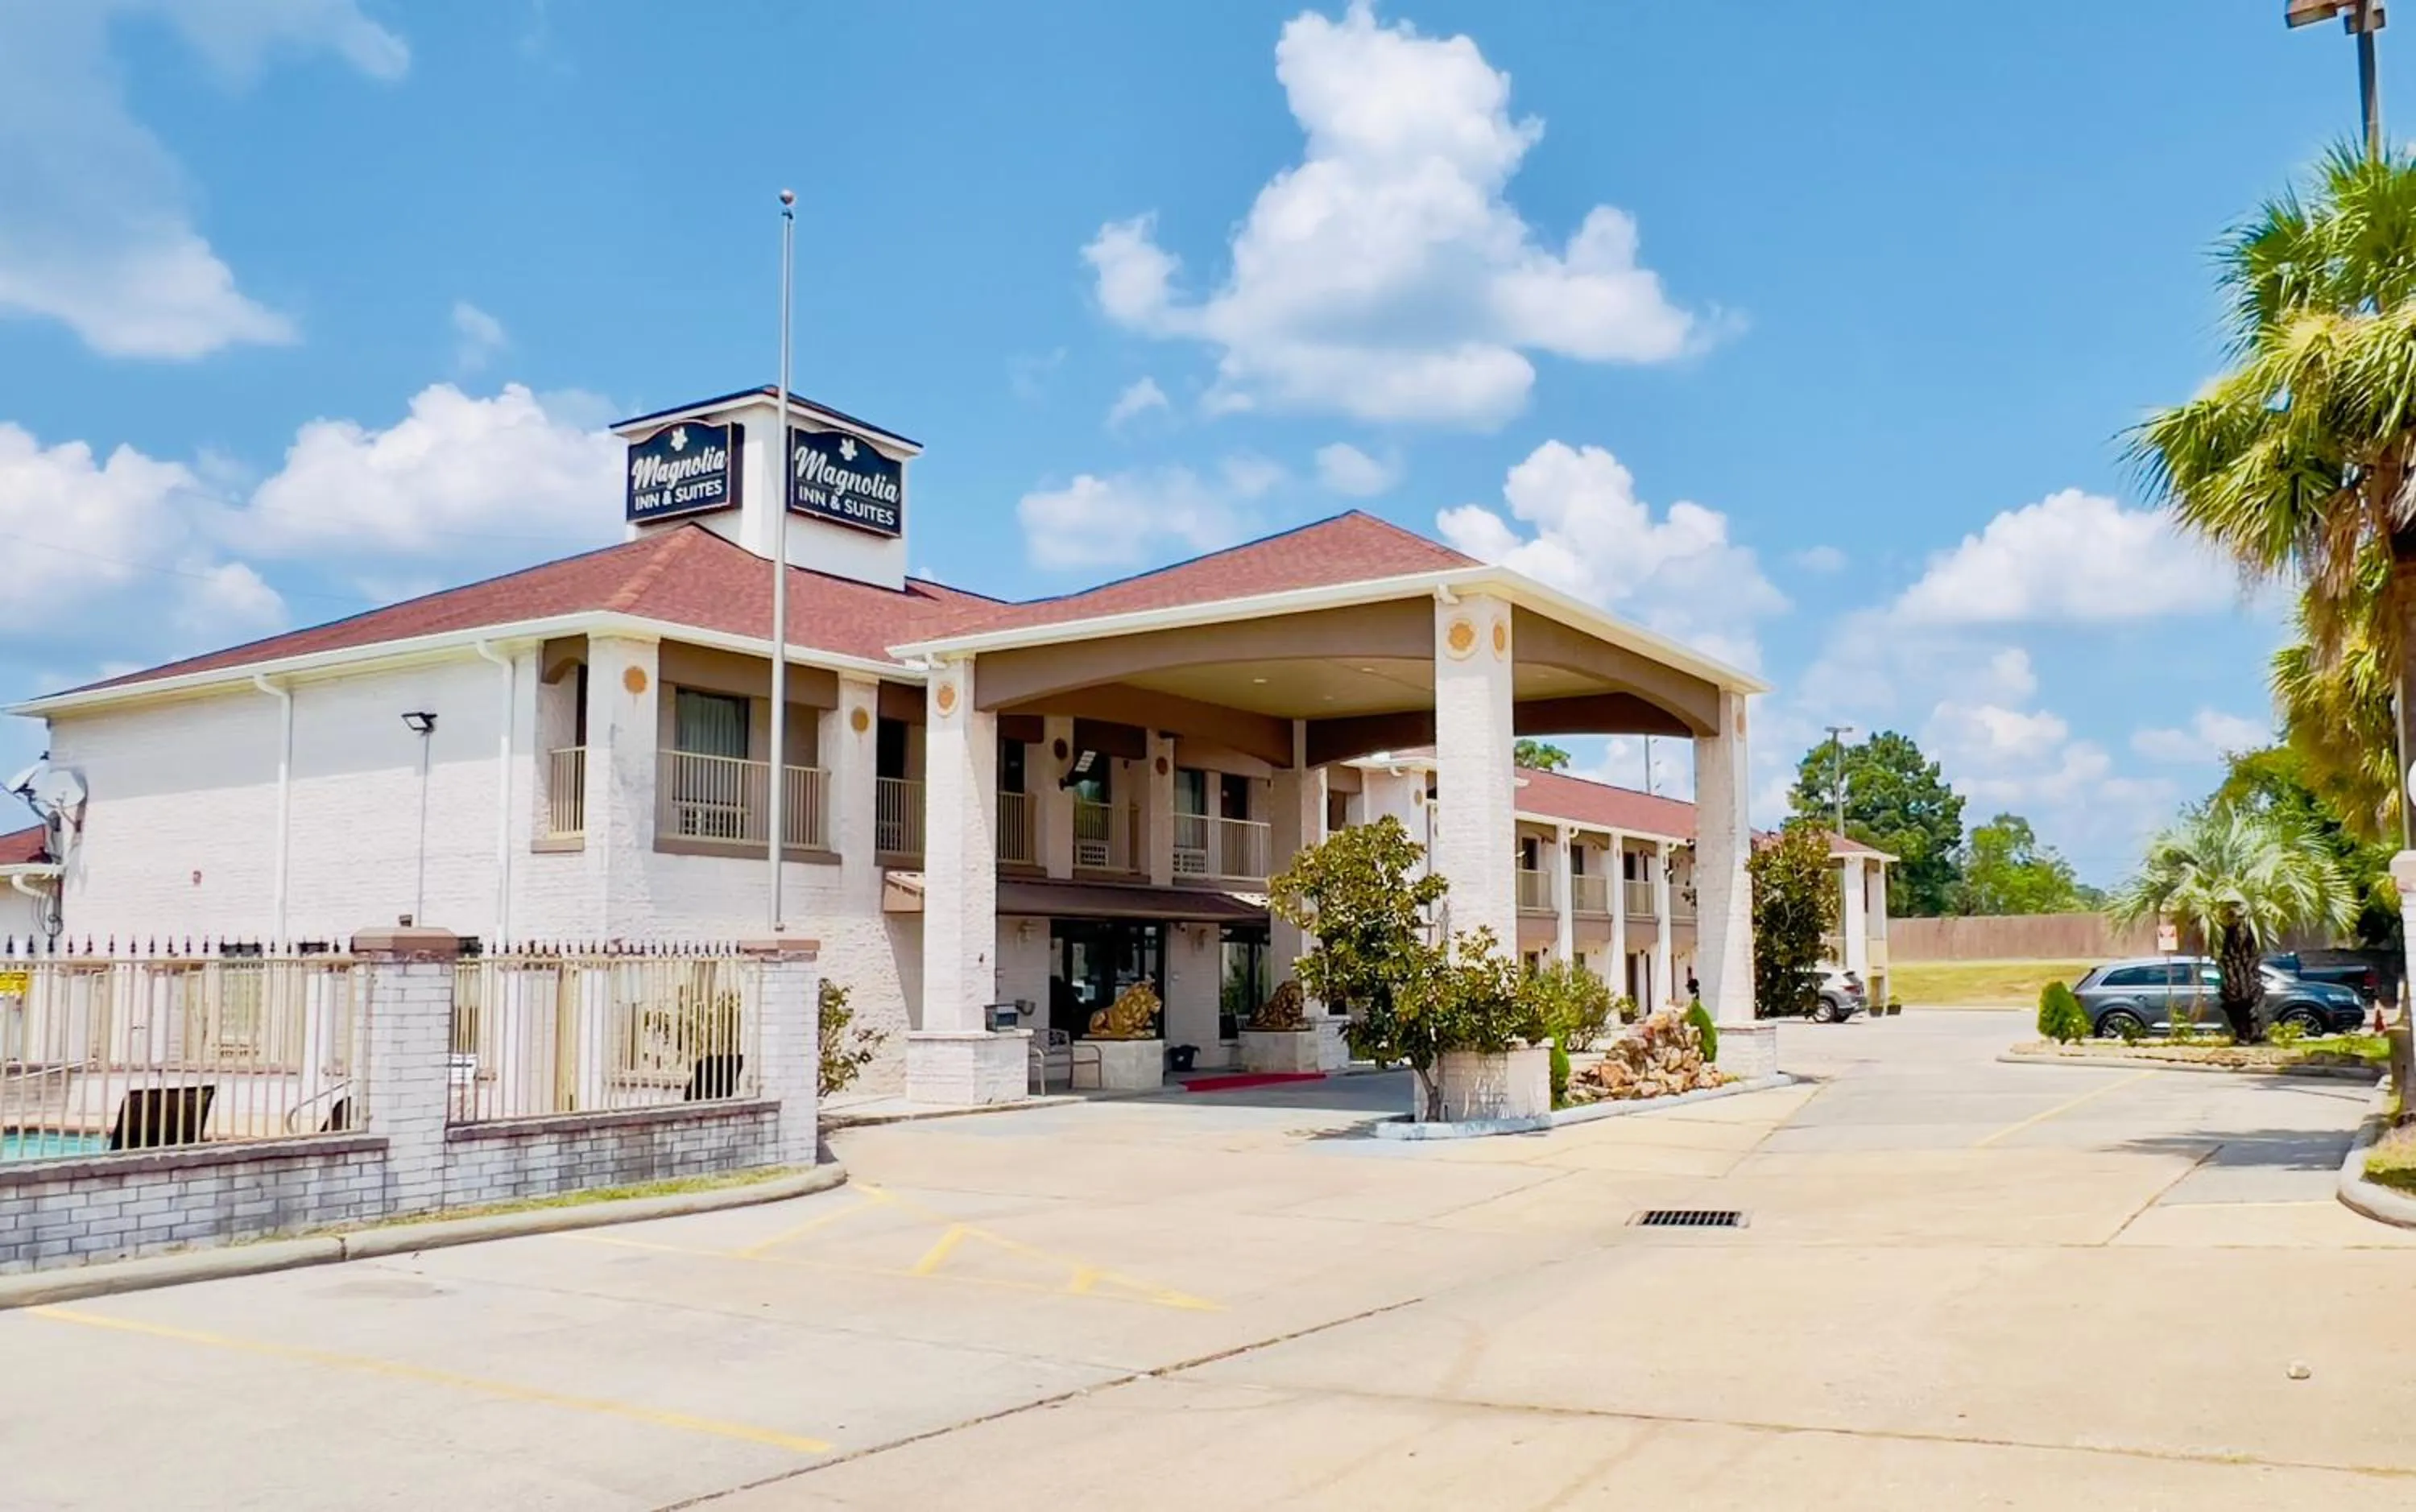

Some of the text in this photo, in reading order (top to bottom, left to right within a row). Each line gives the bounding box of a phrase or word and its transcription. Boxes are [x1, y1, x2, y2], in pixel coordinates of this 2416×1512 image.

[631, 445, 726, 490] Magnolia
[794, 445, 900, 503] Magnolia
[635, 479, 723, 511] INN & SUITES
[798, 484, 896, 527] INN & SUITES
